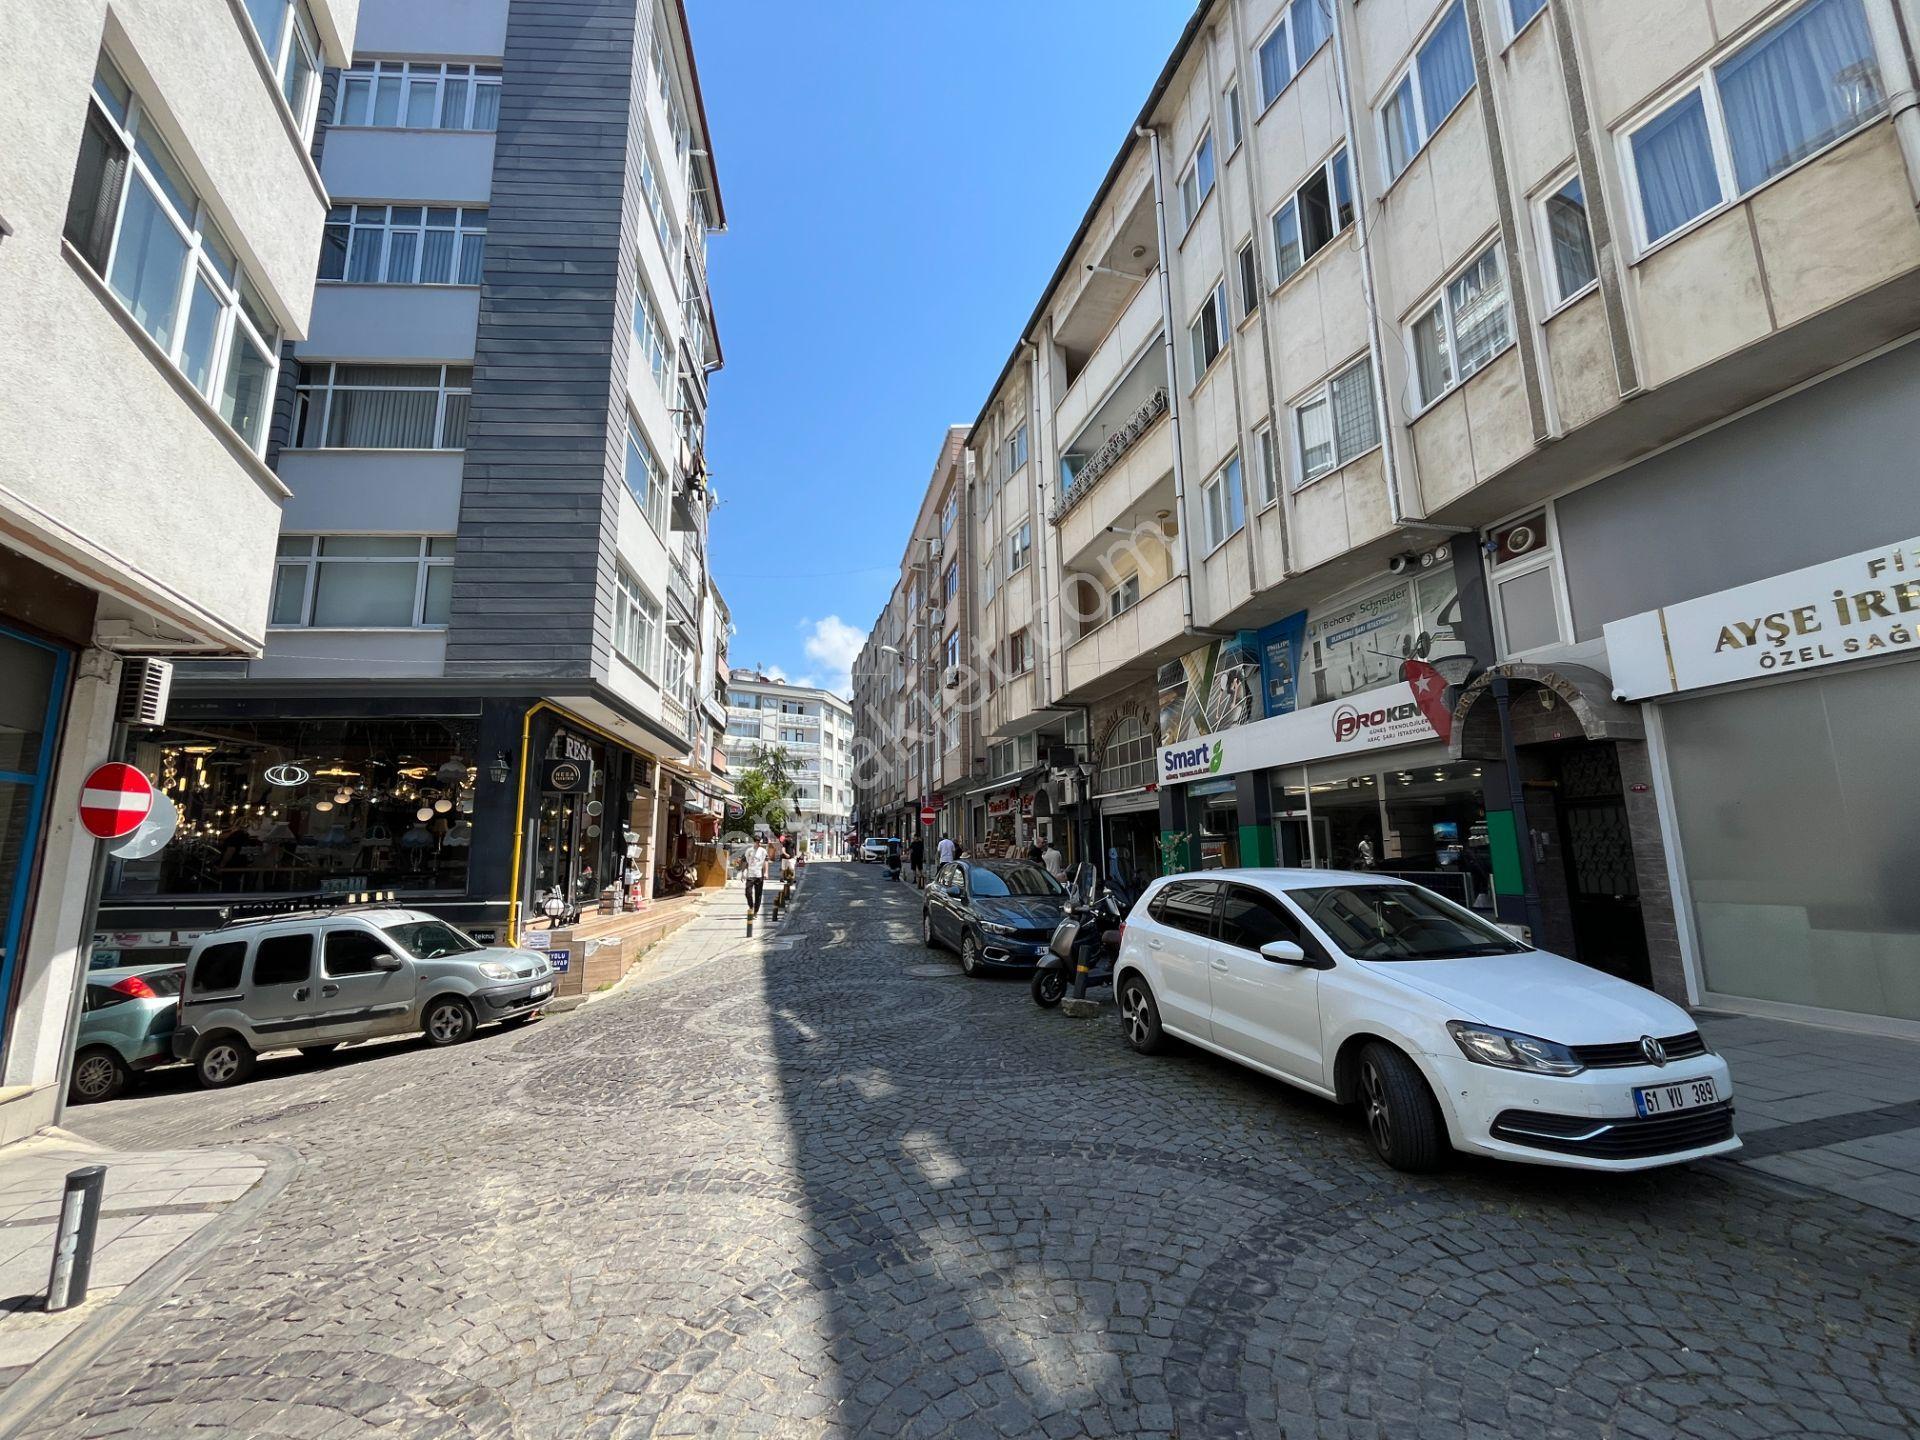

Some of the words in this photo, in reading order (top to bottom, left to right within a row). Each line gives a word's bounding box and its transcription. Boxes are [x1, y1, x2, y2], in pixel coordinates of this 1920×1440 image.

[1359, 588, 1407, 616] Schneider
[1714, 604, 1822, 653] AYŞE
[1759, 644, 1834, 669] ÖZEL
[1844, 623, 1920, 653] SAĞ
[565, 737, 593, 760] RESA
[1164, 743, 1210, 771] Smart
[1644, 1091, 1660, 1112] 61
[1691, 1081, 1714, 1104] 389
